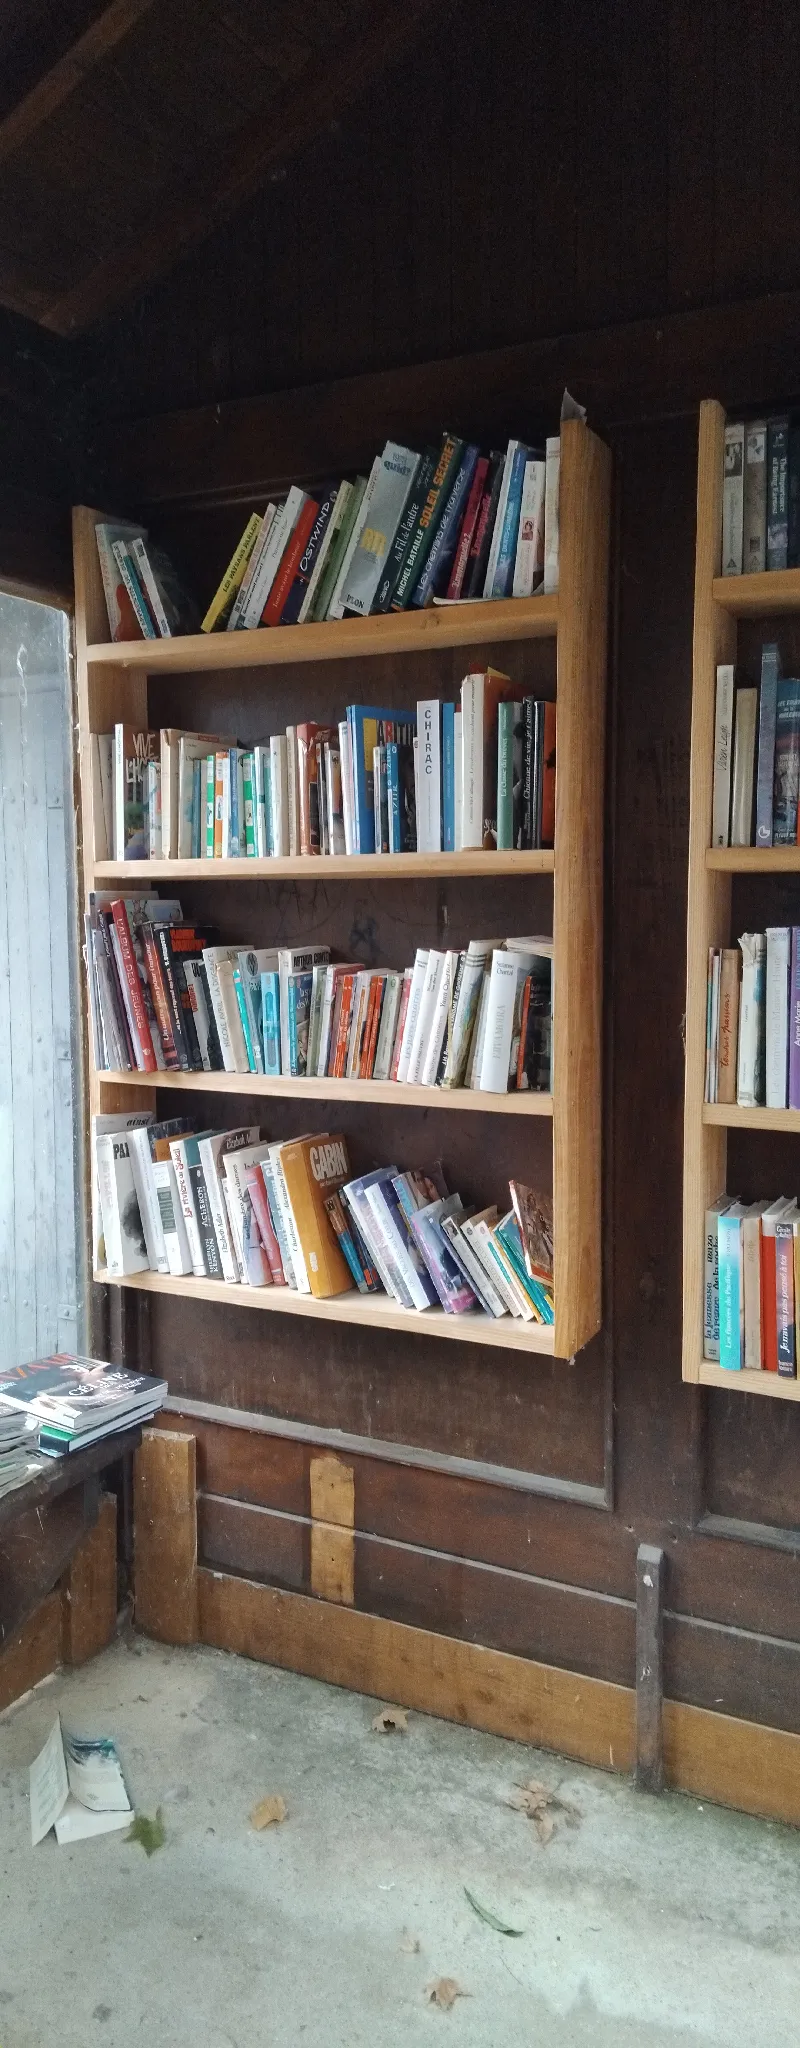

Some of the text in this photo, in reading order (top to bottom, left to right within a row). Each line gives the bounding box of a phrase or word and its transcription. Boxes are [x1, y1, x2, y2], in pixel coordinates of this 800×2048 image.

[395, 438, 456, 596] MICHEL BATAILLE SOLEIL SECRET
[400, 501, 419, 531] l'autre
[299, 501, 331, 572] OSTWIND
[394, 538, 407, 551] Fil
[221, 579, 231, 592] LES
[228, 548, 246, 579] PAYSANS
[242, 517, 260, 548] PARLENT
[393, 551, 403, 562] Au
[424, 709, 433, 775] CHIRAC
[114, 918, 145, 1029] L'ALBUM DES JEUNES
[150, 971, 159, 990] pour
[213, 987, 220, 996] LA
[439, 991, 448, 1007] Yann
[215, 1001, 225, 1020] AVRIL
[161, 1029, 169, 1041] Un
[219, 1022, 230, 1047] NICOLE
[126, 1118, 150, 1127] ainsi
[272, 1156, 284, 1177] Ripley
[311, 1142, 348, 1180] GABIN
[230, 1163, 241, 1187] dames
[196, 1185, 209, 1227] ACHERON
[277, 1178, 290, 1211] Alexandra
[183, 1206, 192, 1218] La
[214, 1212, 228, 1252] Elizabeth Adler
[208, 1237, 218, 1272] KENYON
[780, 1298, 788, 1313] pas
[779, 1342, 790, 1353] Je
